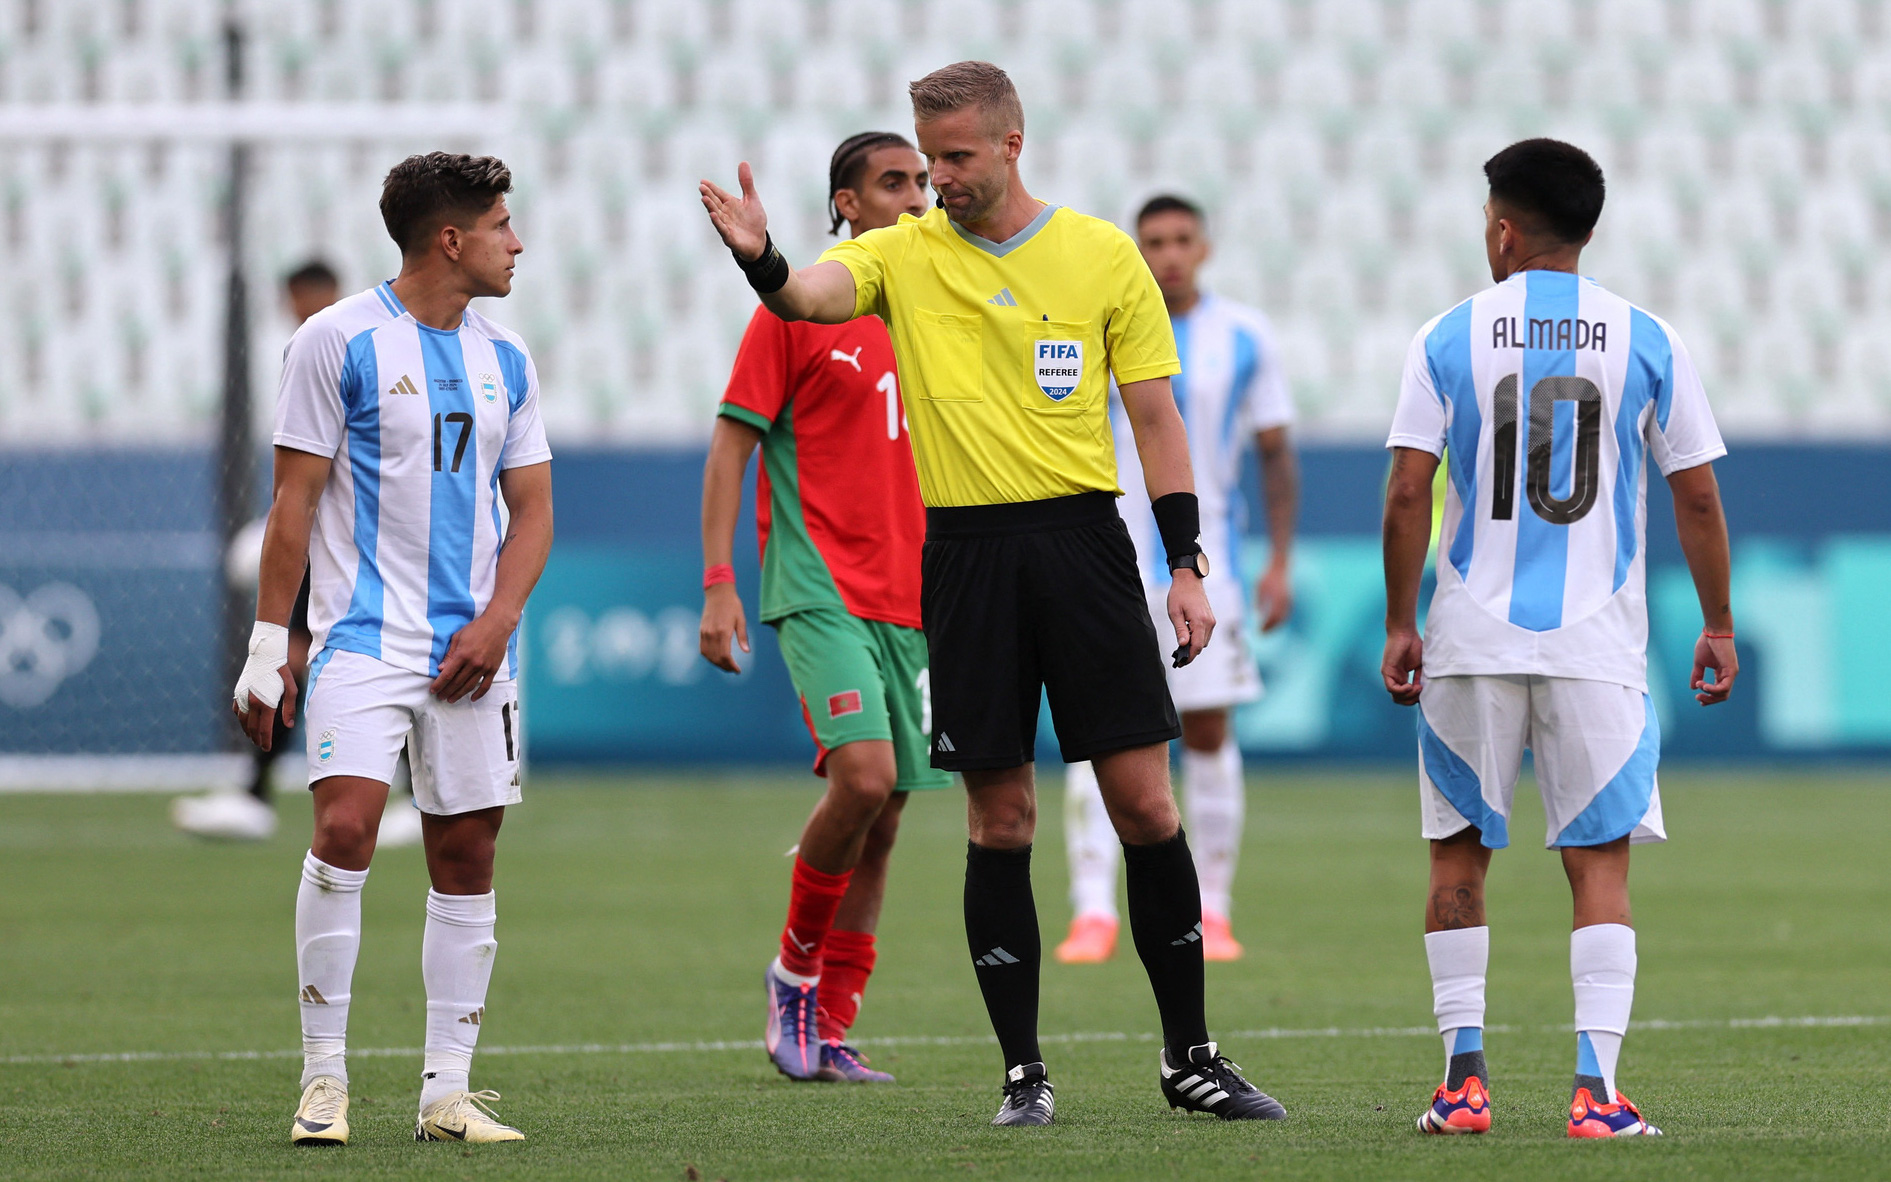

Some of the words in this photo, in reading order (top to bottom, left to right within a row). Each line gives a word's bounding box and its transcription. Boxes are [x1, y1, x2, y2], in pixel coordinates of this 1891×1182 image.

[1039, 344, 1079, 359] FIFA
[1493, 317, 1606, 352] ALMADA
[1038, 368, 1078, 377] REFEREE
[1049, 388, 1067, 396] 2024
[876, 370, 909, 441] 1
[433, 412, 473, 473] 17
[1491, 373, 1601, 525] 10
[501, 700, 520, 762] 1
